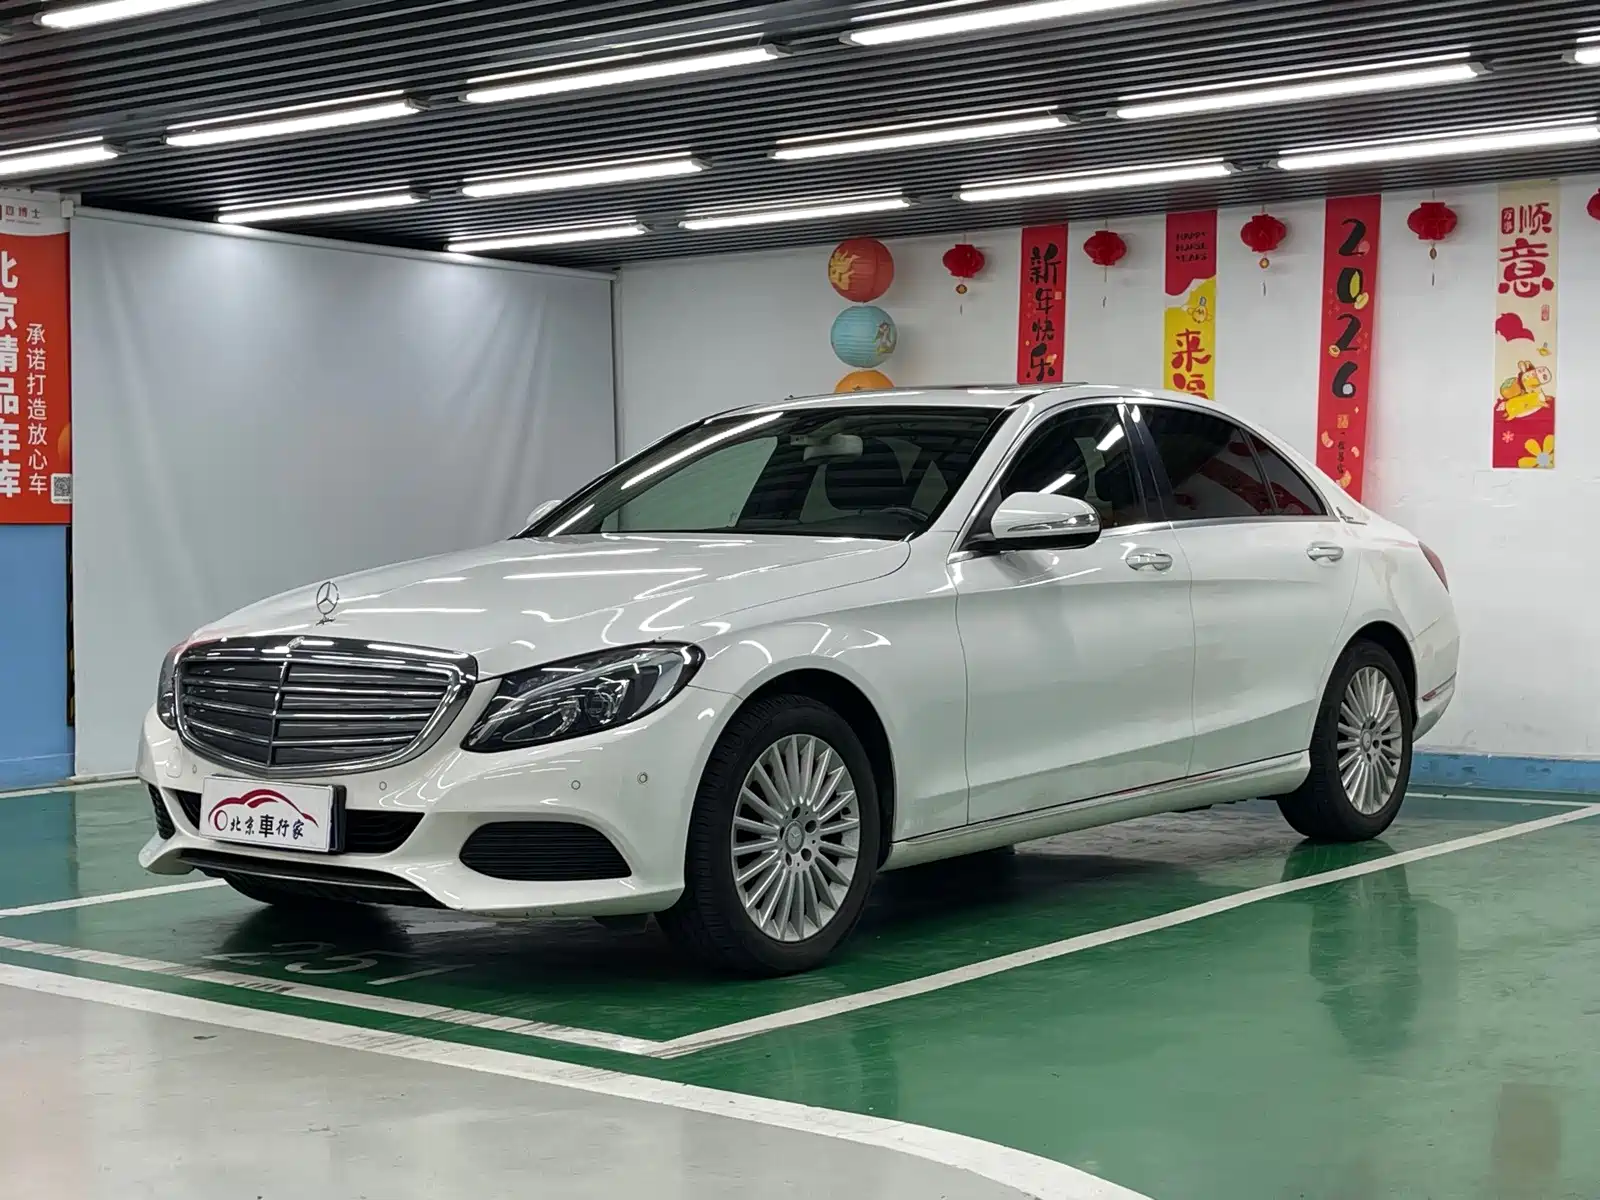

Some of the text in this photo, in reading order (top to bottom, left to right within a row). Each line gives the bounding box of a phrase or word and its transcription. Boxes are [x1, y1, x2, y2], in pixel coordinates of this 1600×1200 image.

[1029, 242, 1062, 382] 新年快乐
[1332, 218, 1366, 398] 2026
[1498, 202, 1554, 298] 顺意
[26, 323, 48, 495] 承诺打造放心车
